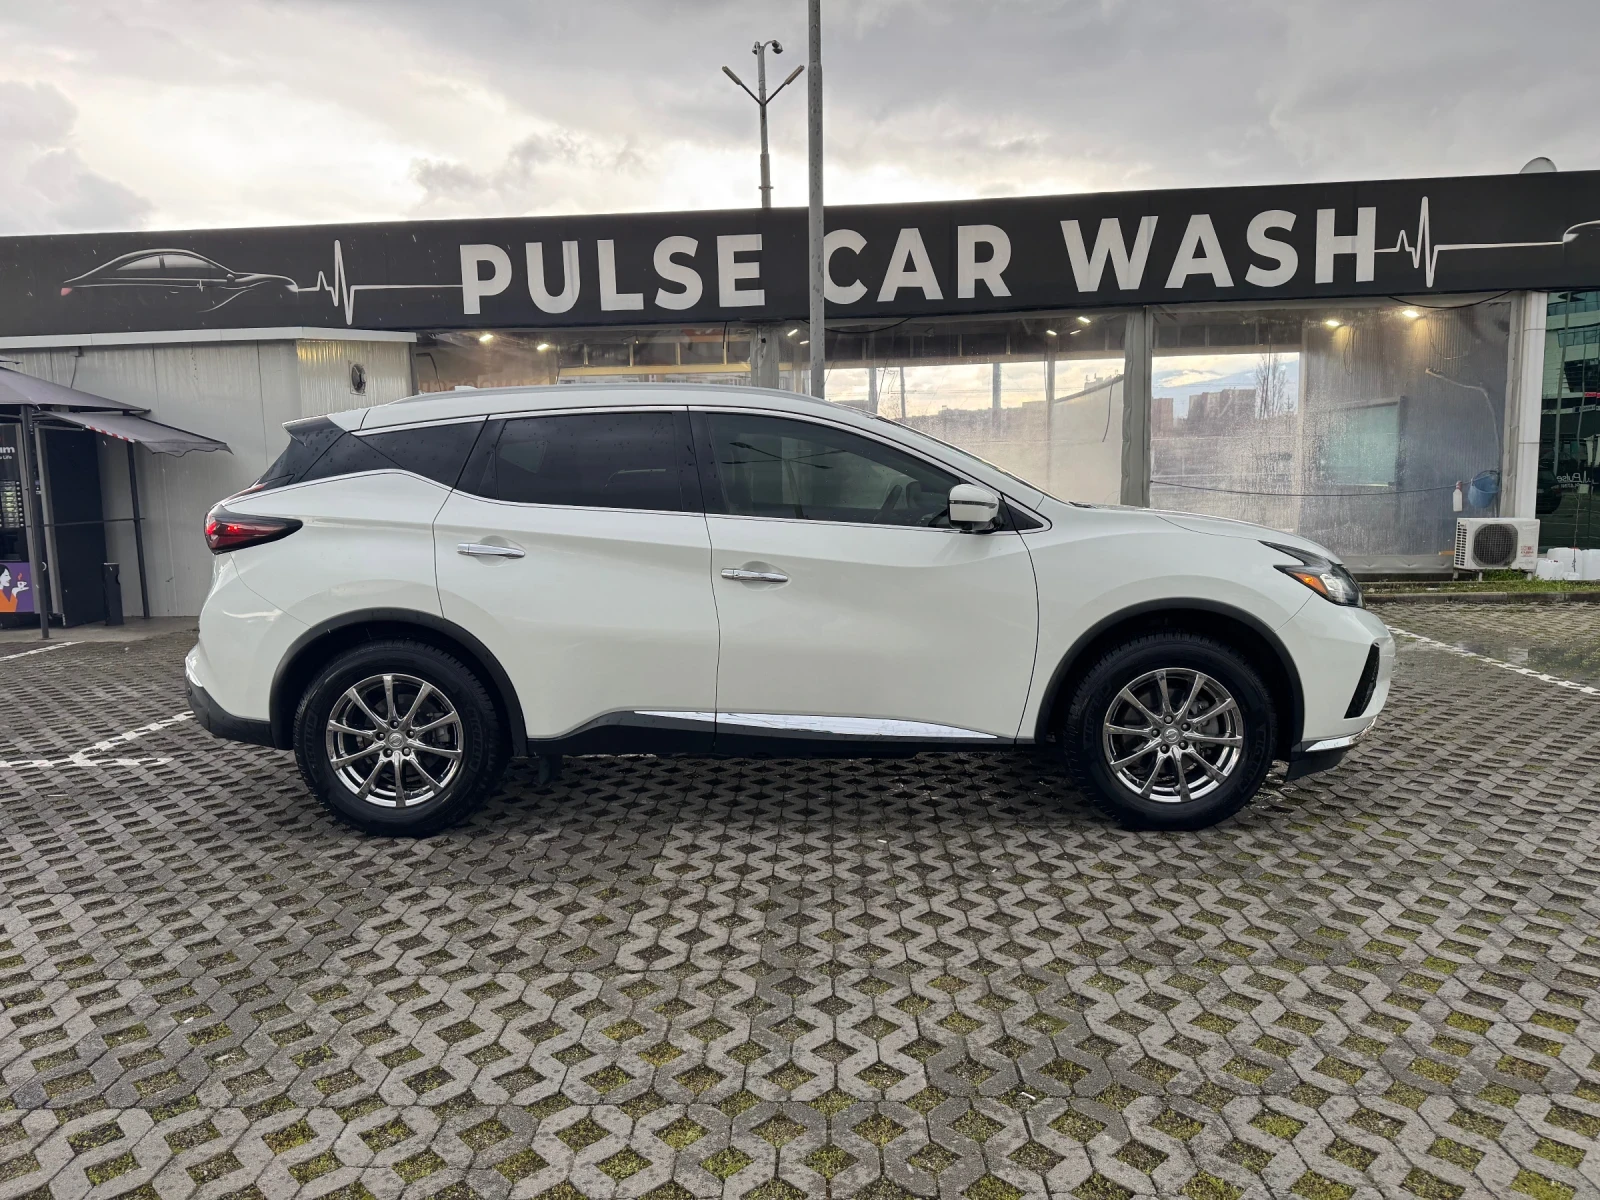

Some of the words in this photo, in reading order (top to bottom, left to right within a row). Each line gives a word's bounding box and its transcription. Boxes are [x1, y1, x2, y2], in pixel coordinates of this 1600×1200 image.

[460, 234, 765, 315] PULSE
[824, 224, 1011, 305] CAR
[1060, 207, 1377, 293] WASH
